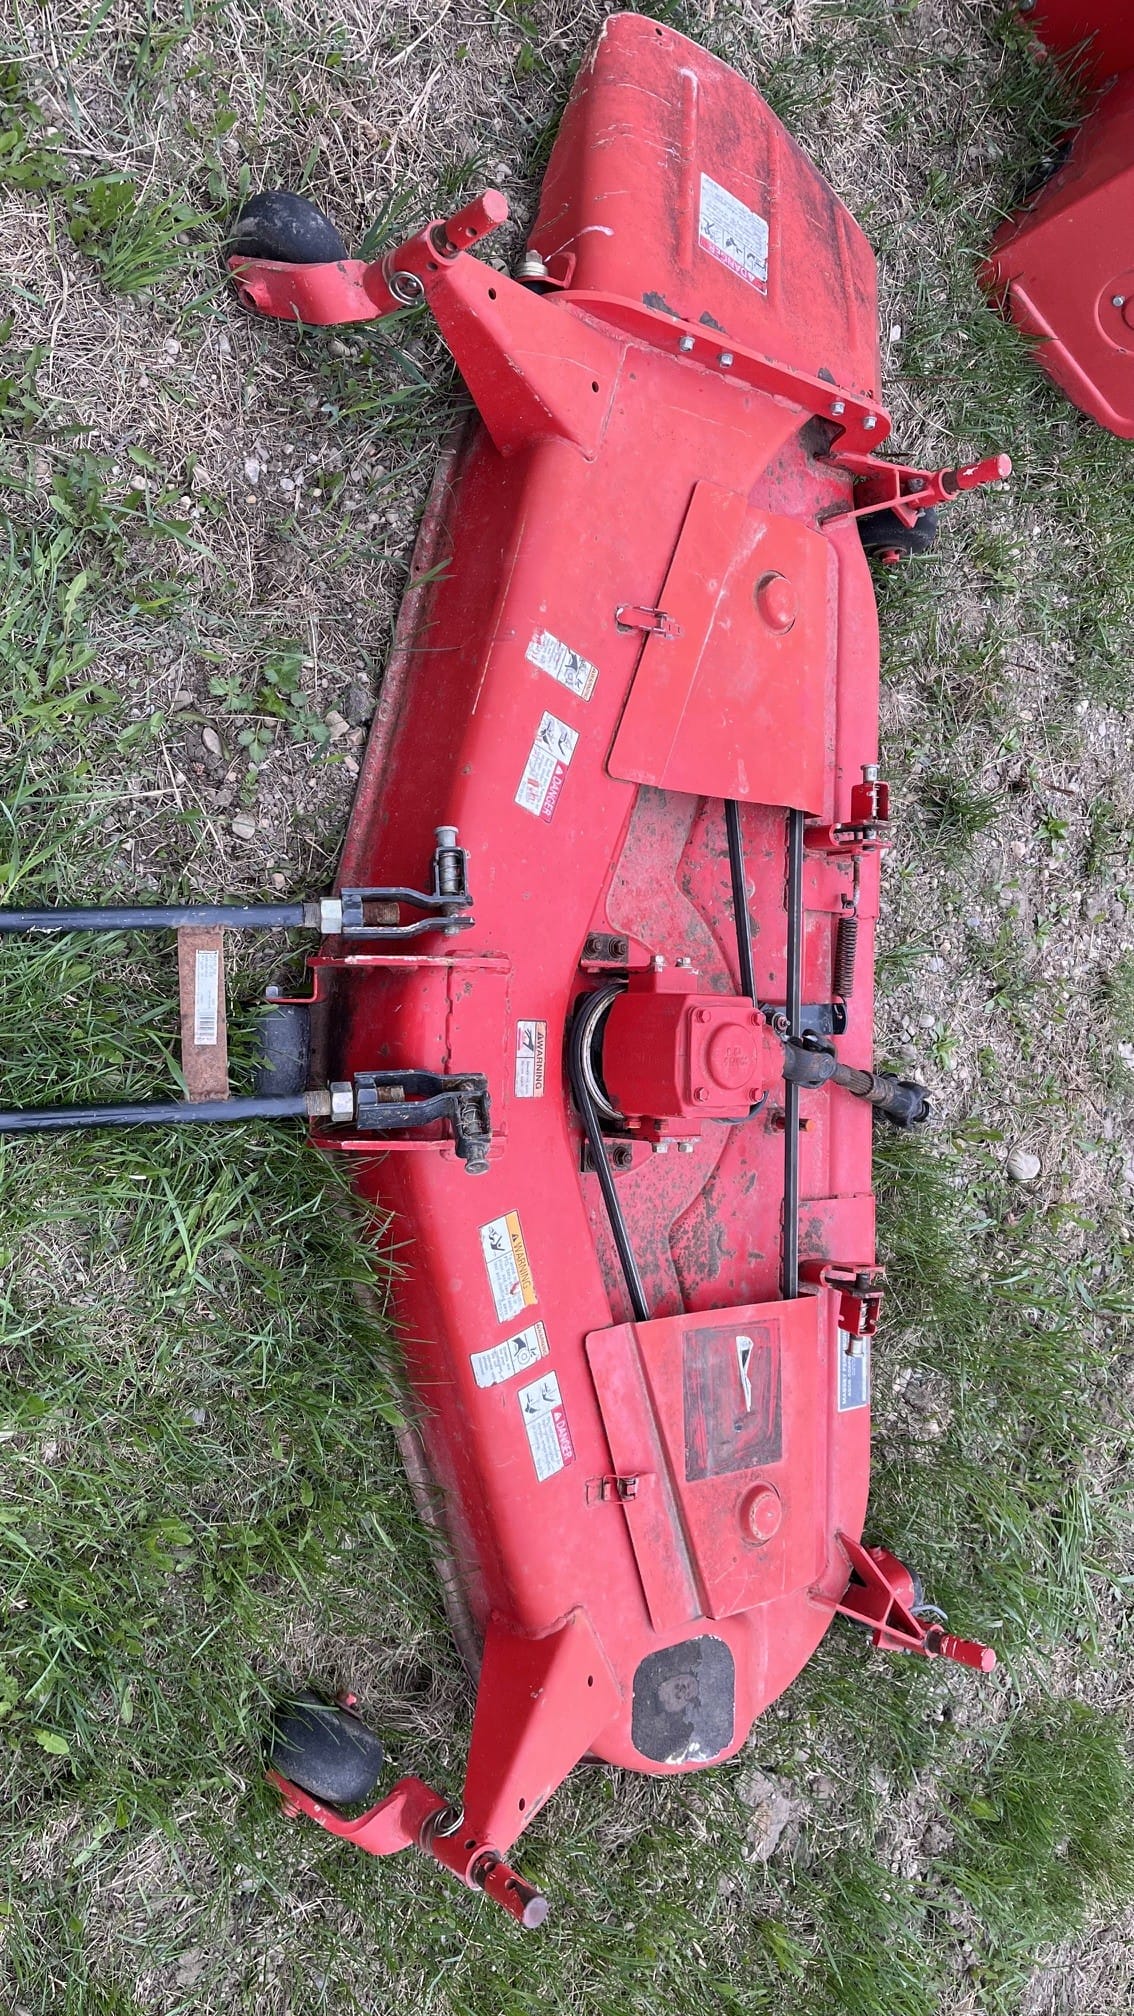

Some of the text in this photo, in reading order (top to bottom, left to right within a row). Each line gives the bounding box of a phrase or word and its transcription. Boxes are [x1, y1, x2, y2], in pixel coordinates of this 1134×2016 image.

[541, 775, 562, 817] DANGER
[535, 1040, 544, 1089] WARNING
[513, 1241, 531, 1290] WARNING
[556, 1421, 573, 1460] DANGER
